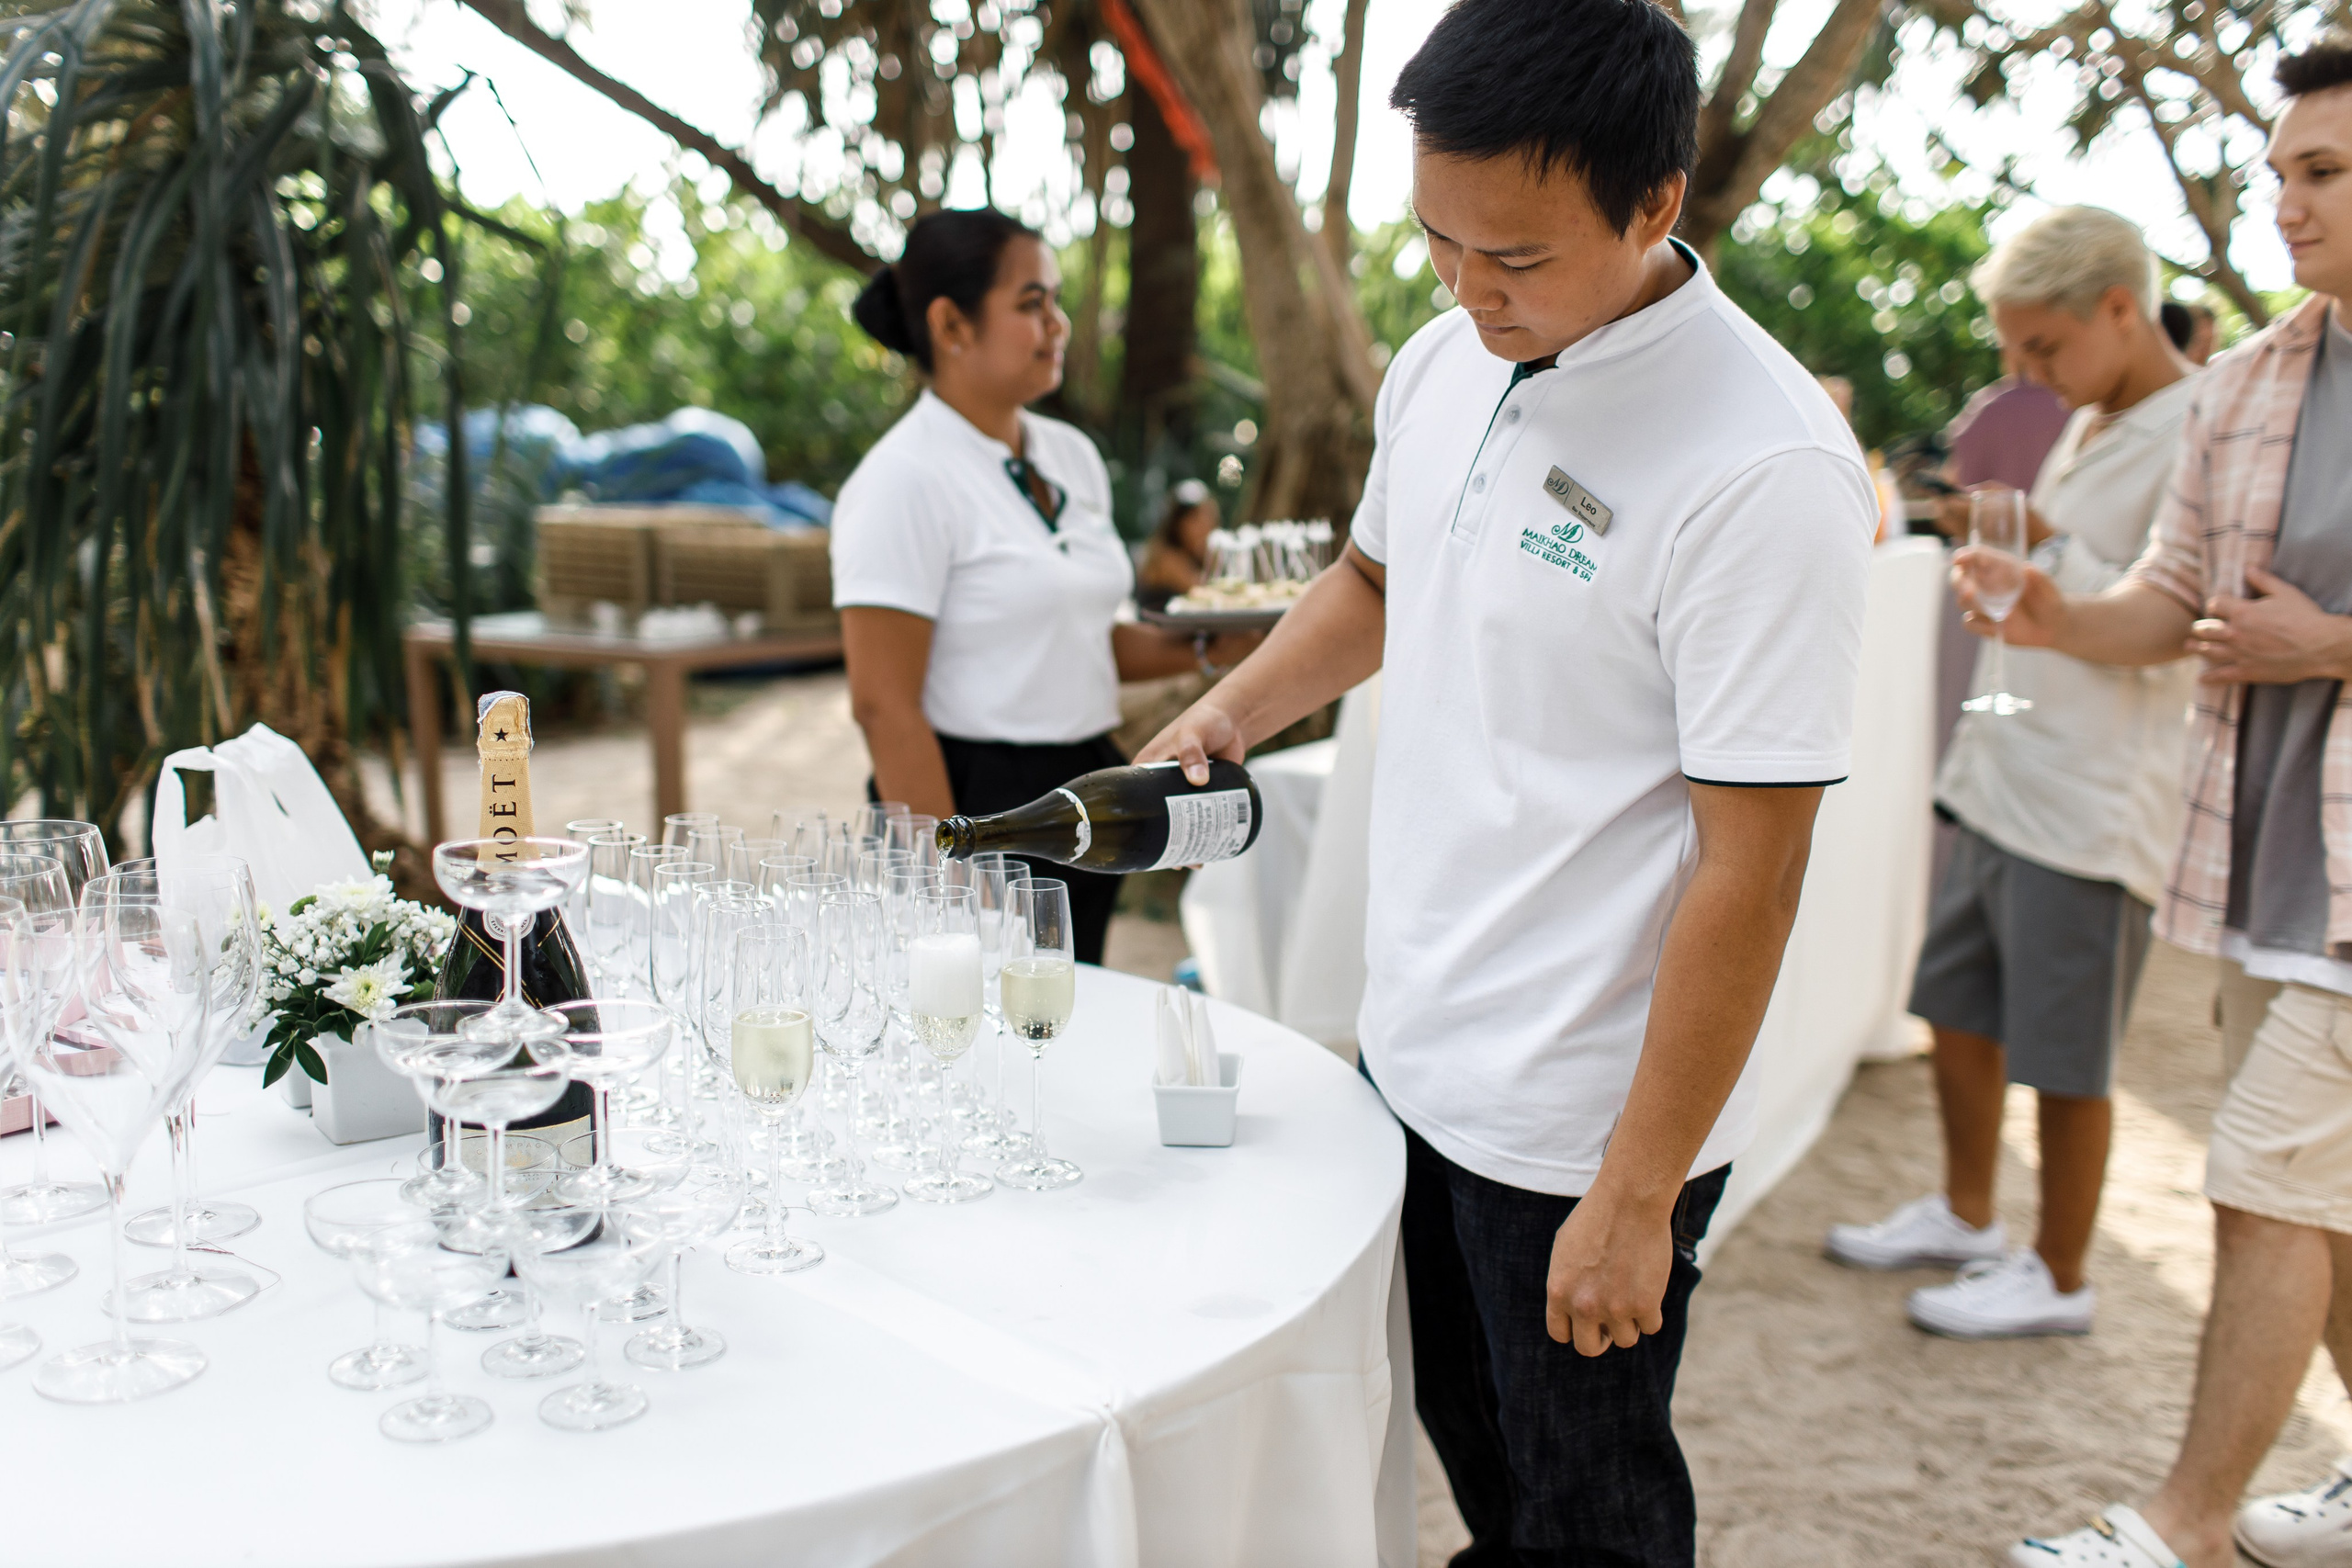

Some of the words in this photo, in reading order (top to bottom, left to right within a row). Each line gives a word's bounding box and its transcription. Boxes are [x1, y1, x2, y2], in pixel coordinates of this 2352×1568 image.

[1580, 497, 1597, 515] Leo
[1521, 528, 1566, 553] MAIKHAO
[1568, 548, 1598, 571] DREAM
[1521, 540, 1541, 556] VILLA
[1542, 551, 1571, 570] RESORT
[1579, 570, 1591, 582] SPA
[475, 1142, 561, 1156] CMPAGNE
